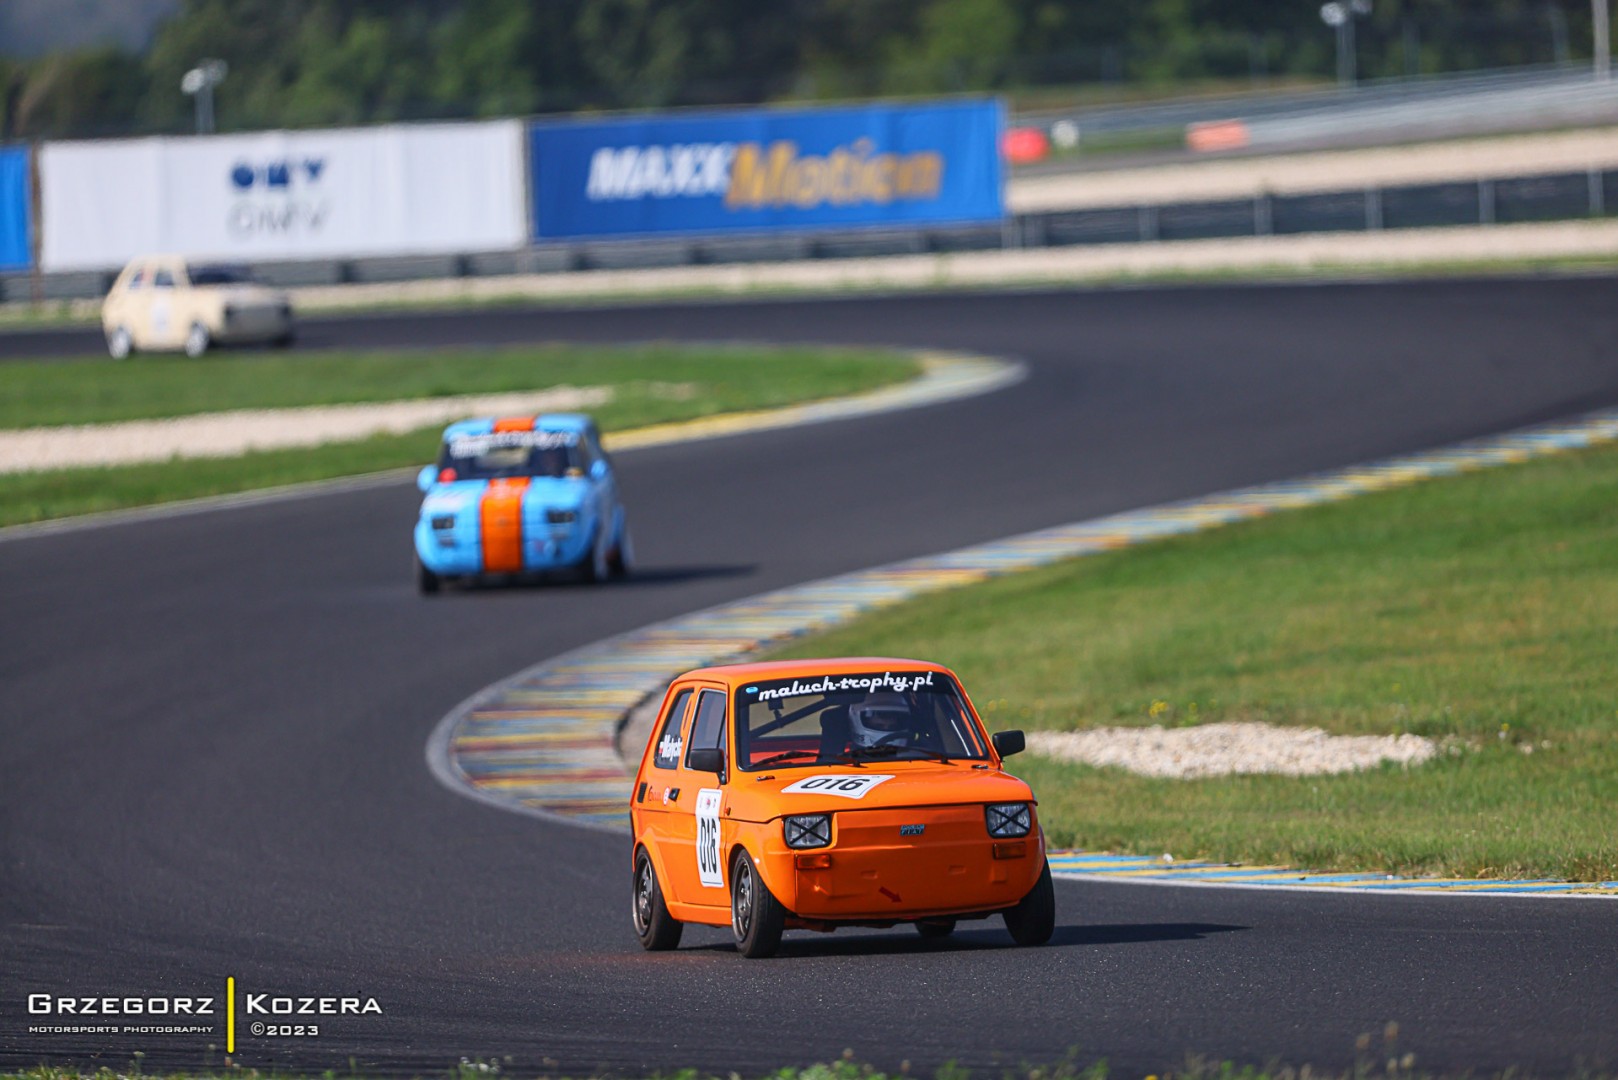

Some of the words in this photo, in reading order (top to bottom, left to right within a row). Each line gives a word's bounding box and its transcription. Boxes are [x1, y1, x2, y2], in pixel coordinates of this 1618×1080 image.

[758, 671, 934, 702] maluch-trophy.pl
[800, 778, 870, 791] 016
[700, 816, 718, 874] 016
